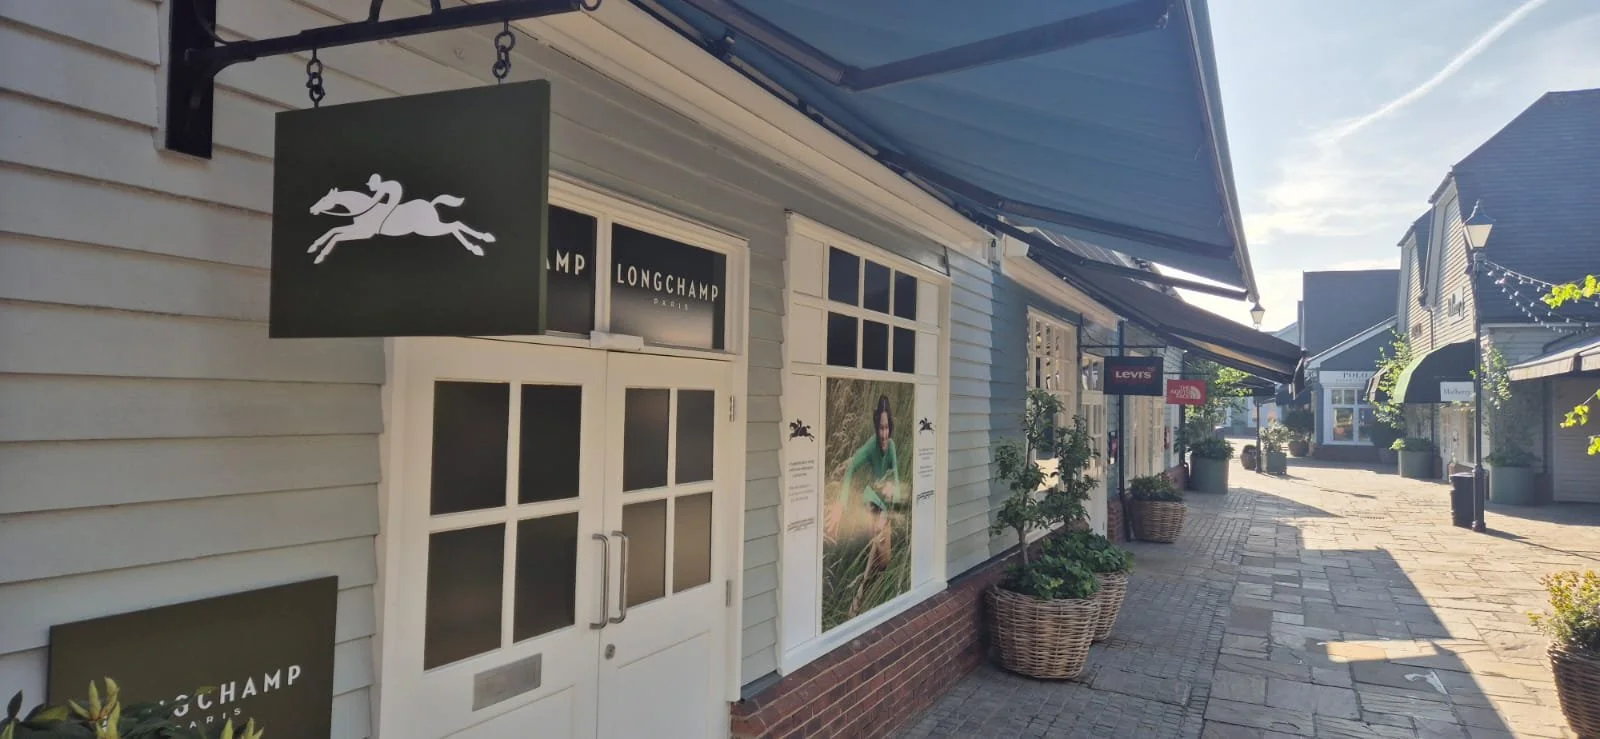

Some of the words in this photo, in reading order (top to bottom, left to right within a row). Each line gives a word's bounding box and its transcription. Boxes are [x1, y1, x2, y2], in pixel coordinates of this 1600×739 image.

[617, 263, 719, 302] LONGCHAMP
[653, 297, 690, 311] PARIS
[175, 707, 242, 729] ARIS
